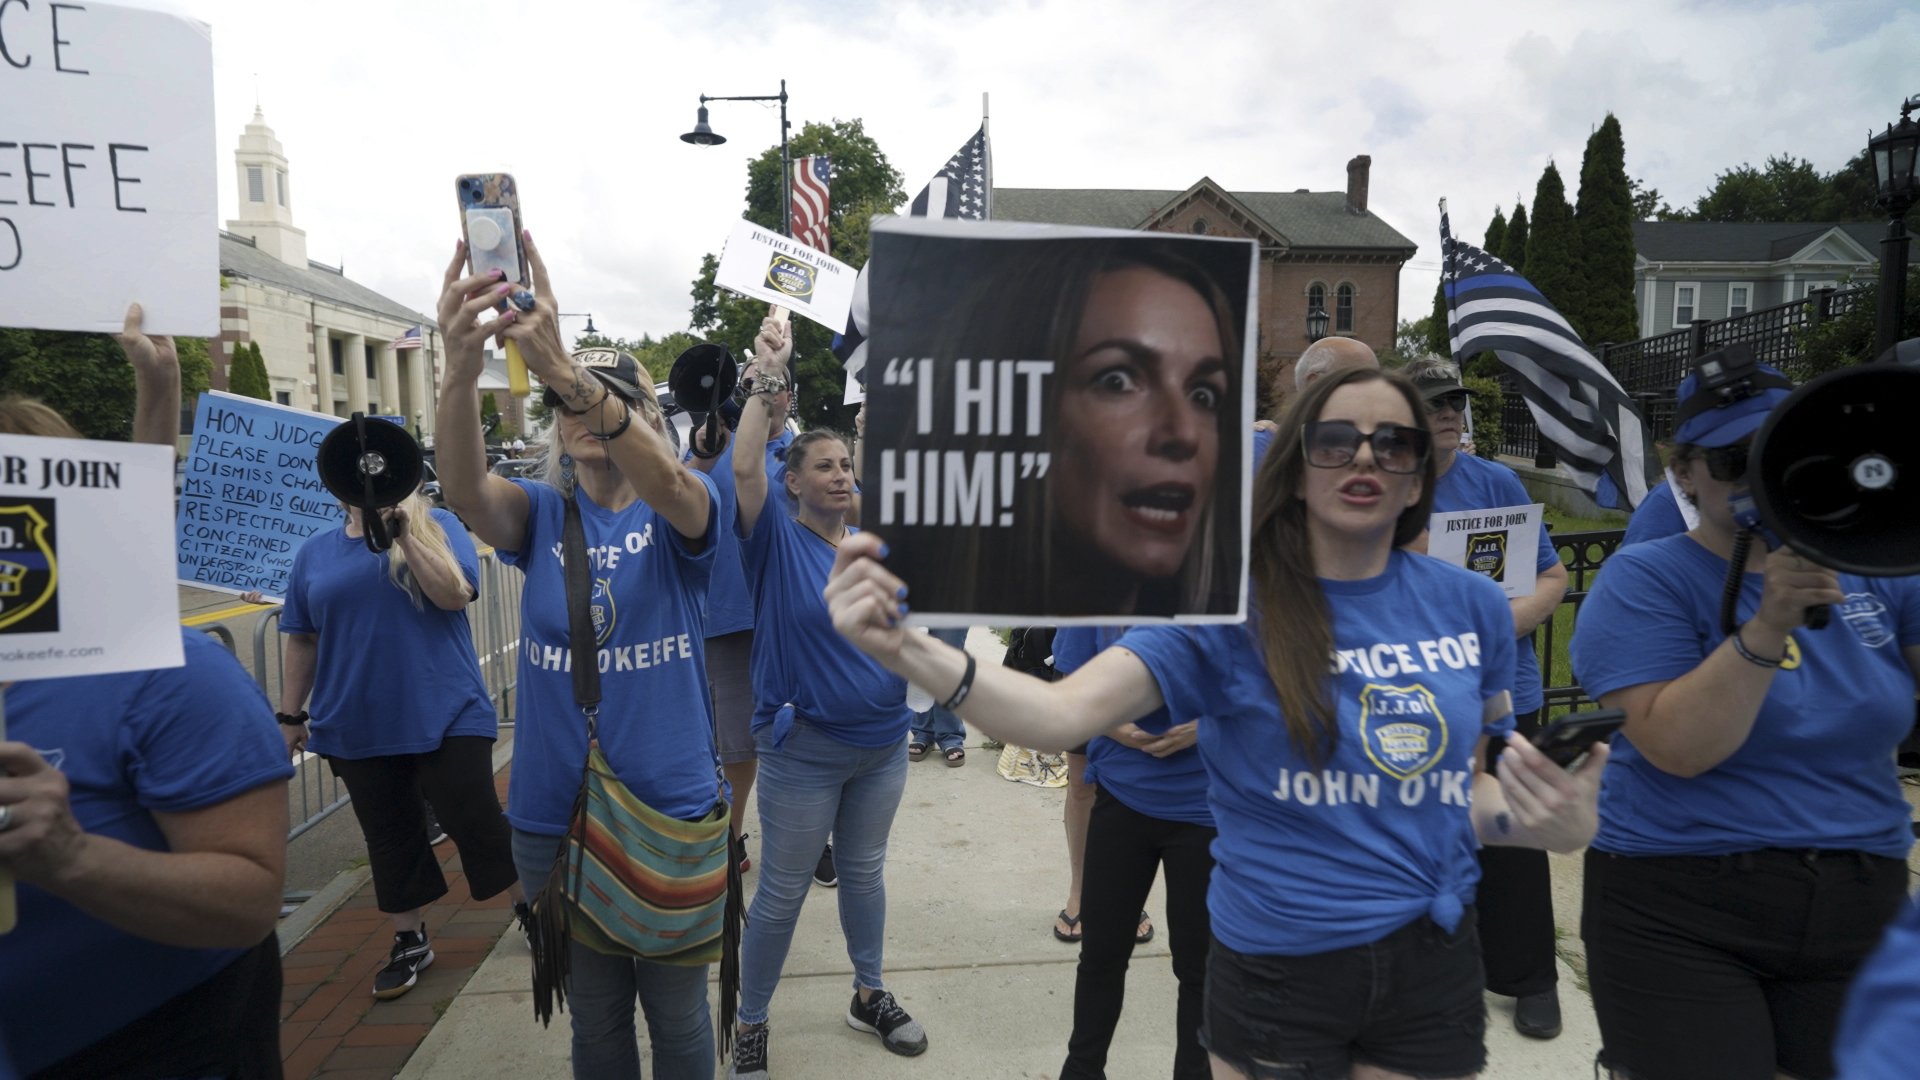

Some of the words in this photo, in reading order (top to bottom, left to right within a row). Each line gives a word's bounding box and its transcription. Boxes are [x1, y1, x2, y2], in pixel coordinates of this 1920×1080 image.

[751, 231, 790, 252] JUSTICE
[792, 247, 813, 262] FOR
[815, 257, 840, 275] JOHN
[954, 358, 1055, 436] HIT
[195, 434, 269, 463] PLEASE
[38, 458, 122, 490] JOHN
[194, 457, 273, 485] DISMISS
[223, 483, 267, 504] READ
[270, 492, 284, 507] IS
[880, 448, 1051, 527] HIM!”
[185, 502, 319, 538] RESPECTFULLY
[1446, 517, 1482, 533] JUSTICE
[1484, 515, 1503, 529] FOR
[1504, 512, 1528, 528] JOHN
[180, 539, 256, 560] CITIZEN
[183, 523, 291, 553] CONCERNED
[178, 553, 264, 574] UNDERSTOOD
[1417, 632, 1481, 673] FOR
[1272, 767, 1380, 808] JOHN
[1398, 769, 1474, 808] O'K
